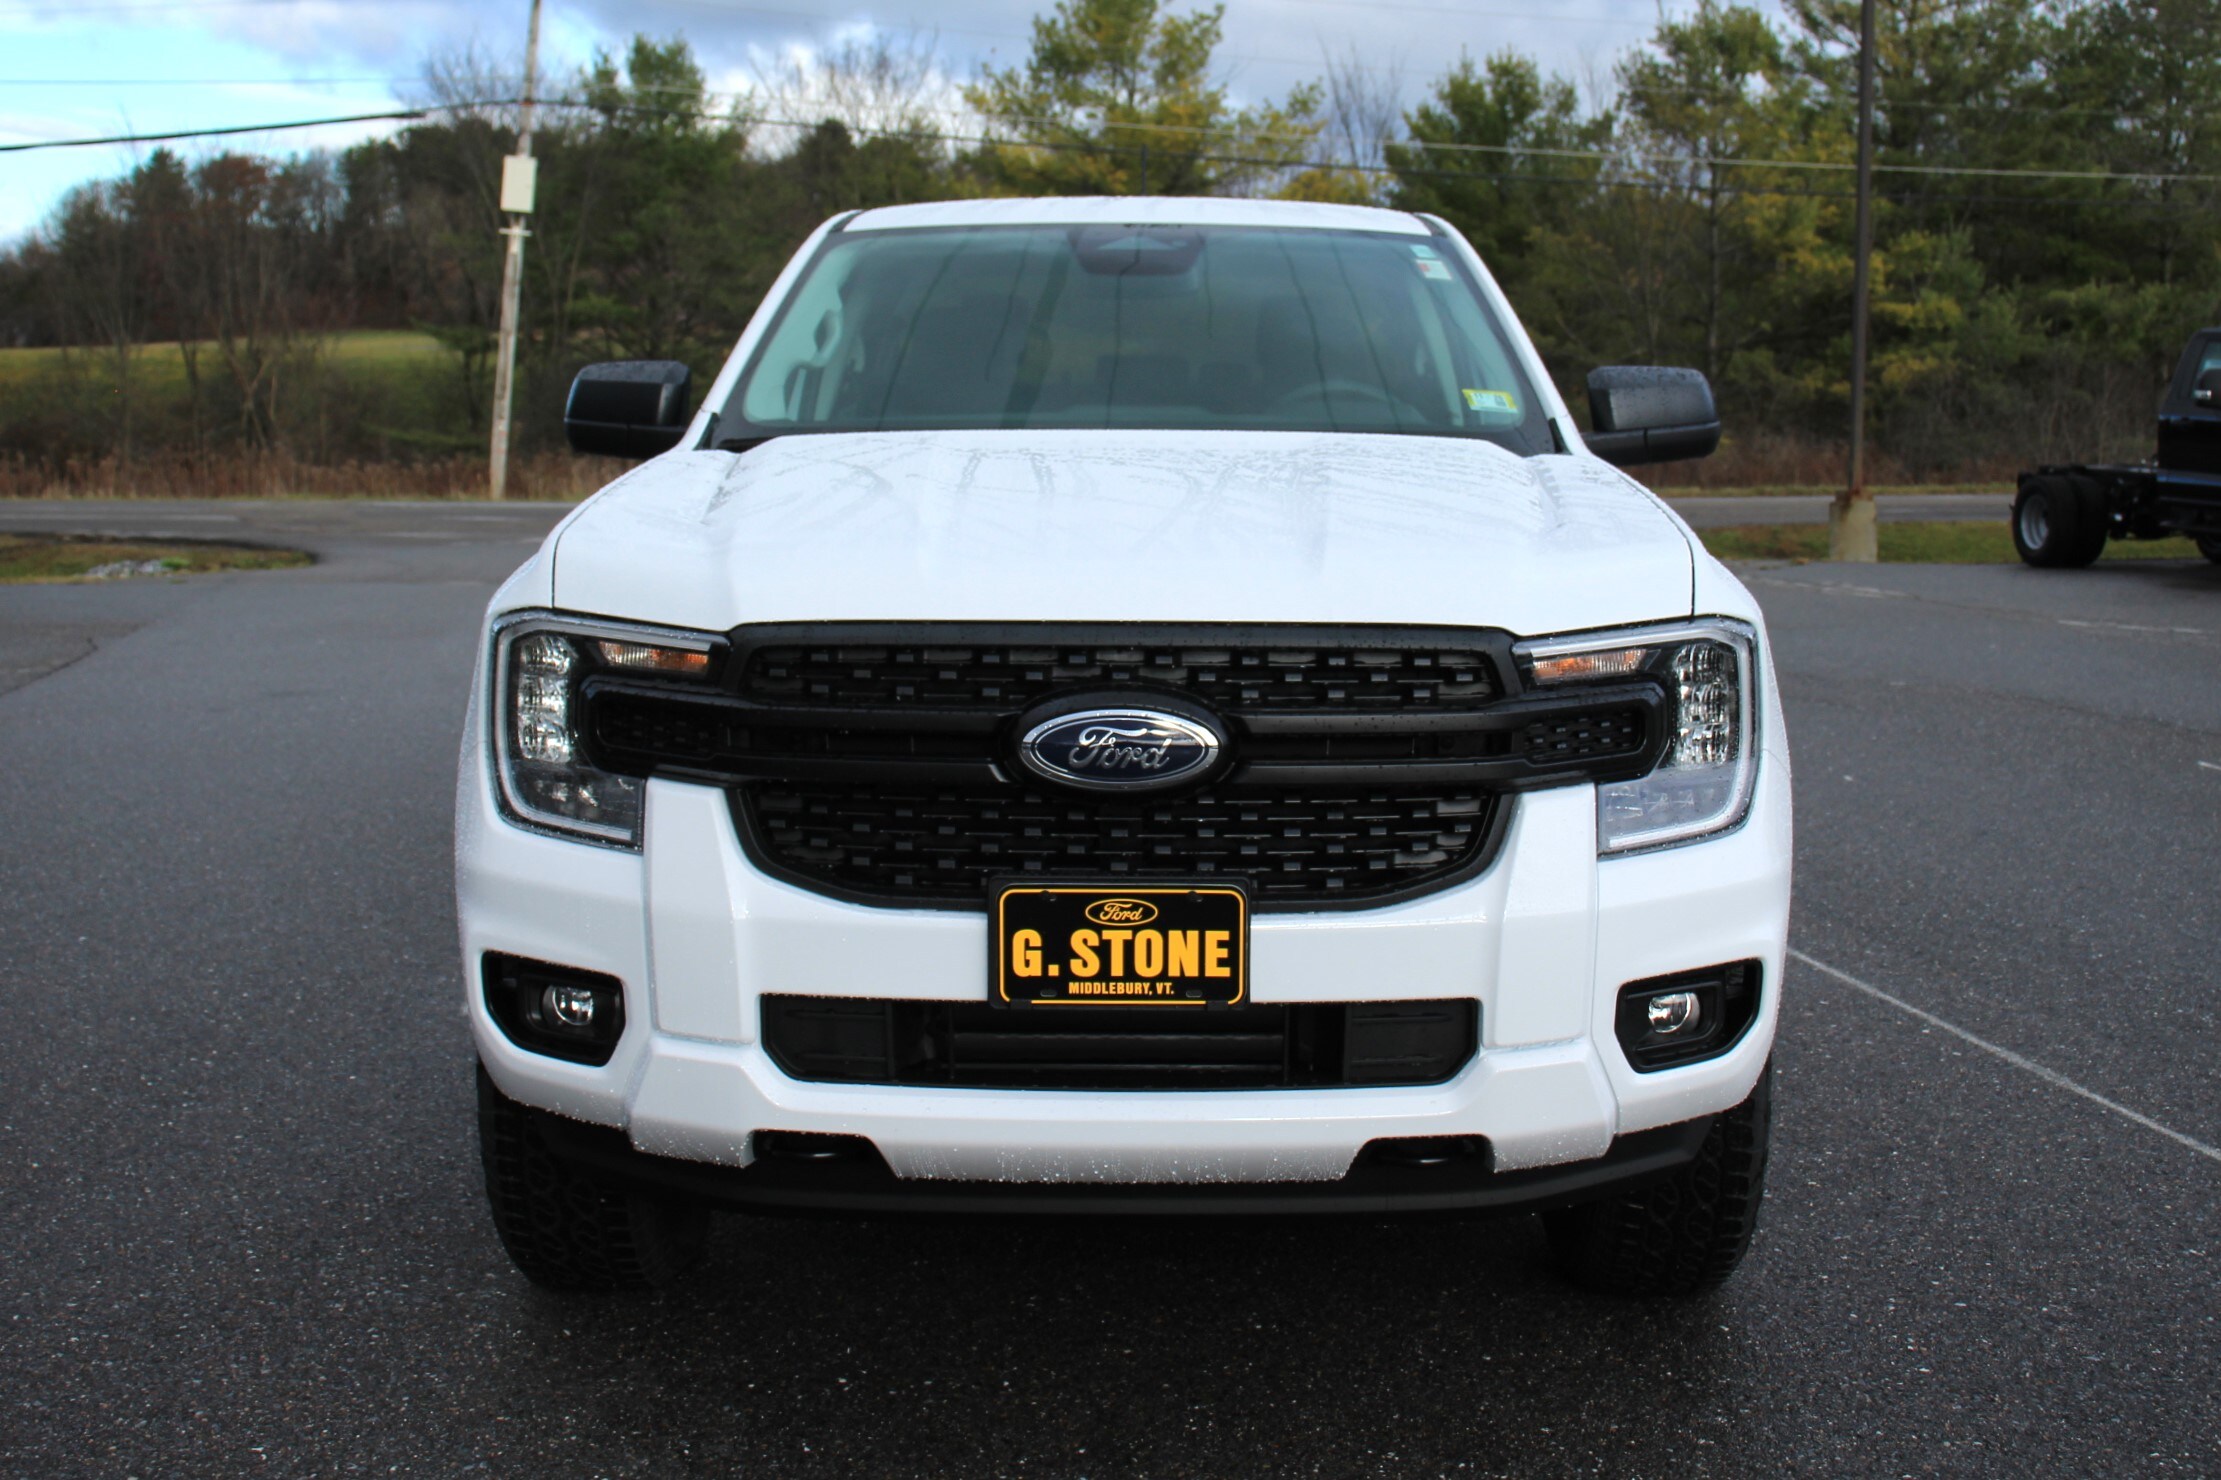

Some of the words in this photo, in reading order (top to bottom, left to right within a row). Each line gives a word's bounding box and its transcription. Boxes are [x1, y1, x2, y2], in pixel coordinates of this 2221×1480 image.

[1068, 726, 1172, 769] Ford
[1099, 902, 1144, 922] Ford
[1012, 929, 1060, 977] G.
[1069, 929, 1231, 977] STONE
[1068, 981, 1153, 996] MIDDLEBURY,
[1156, 981, 1175, 995] VT.
